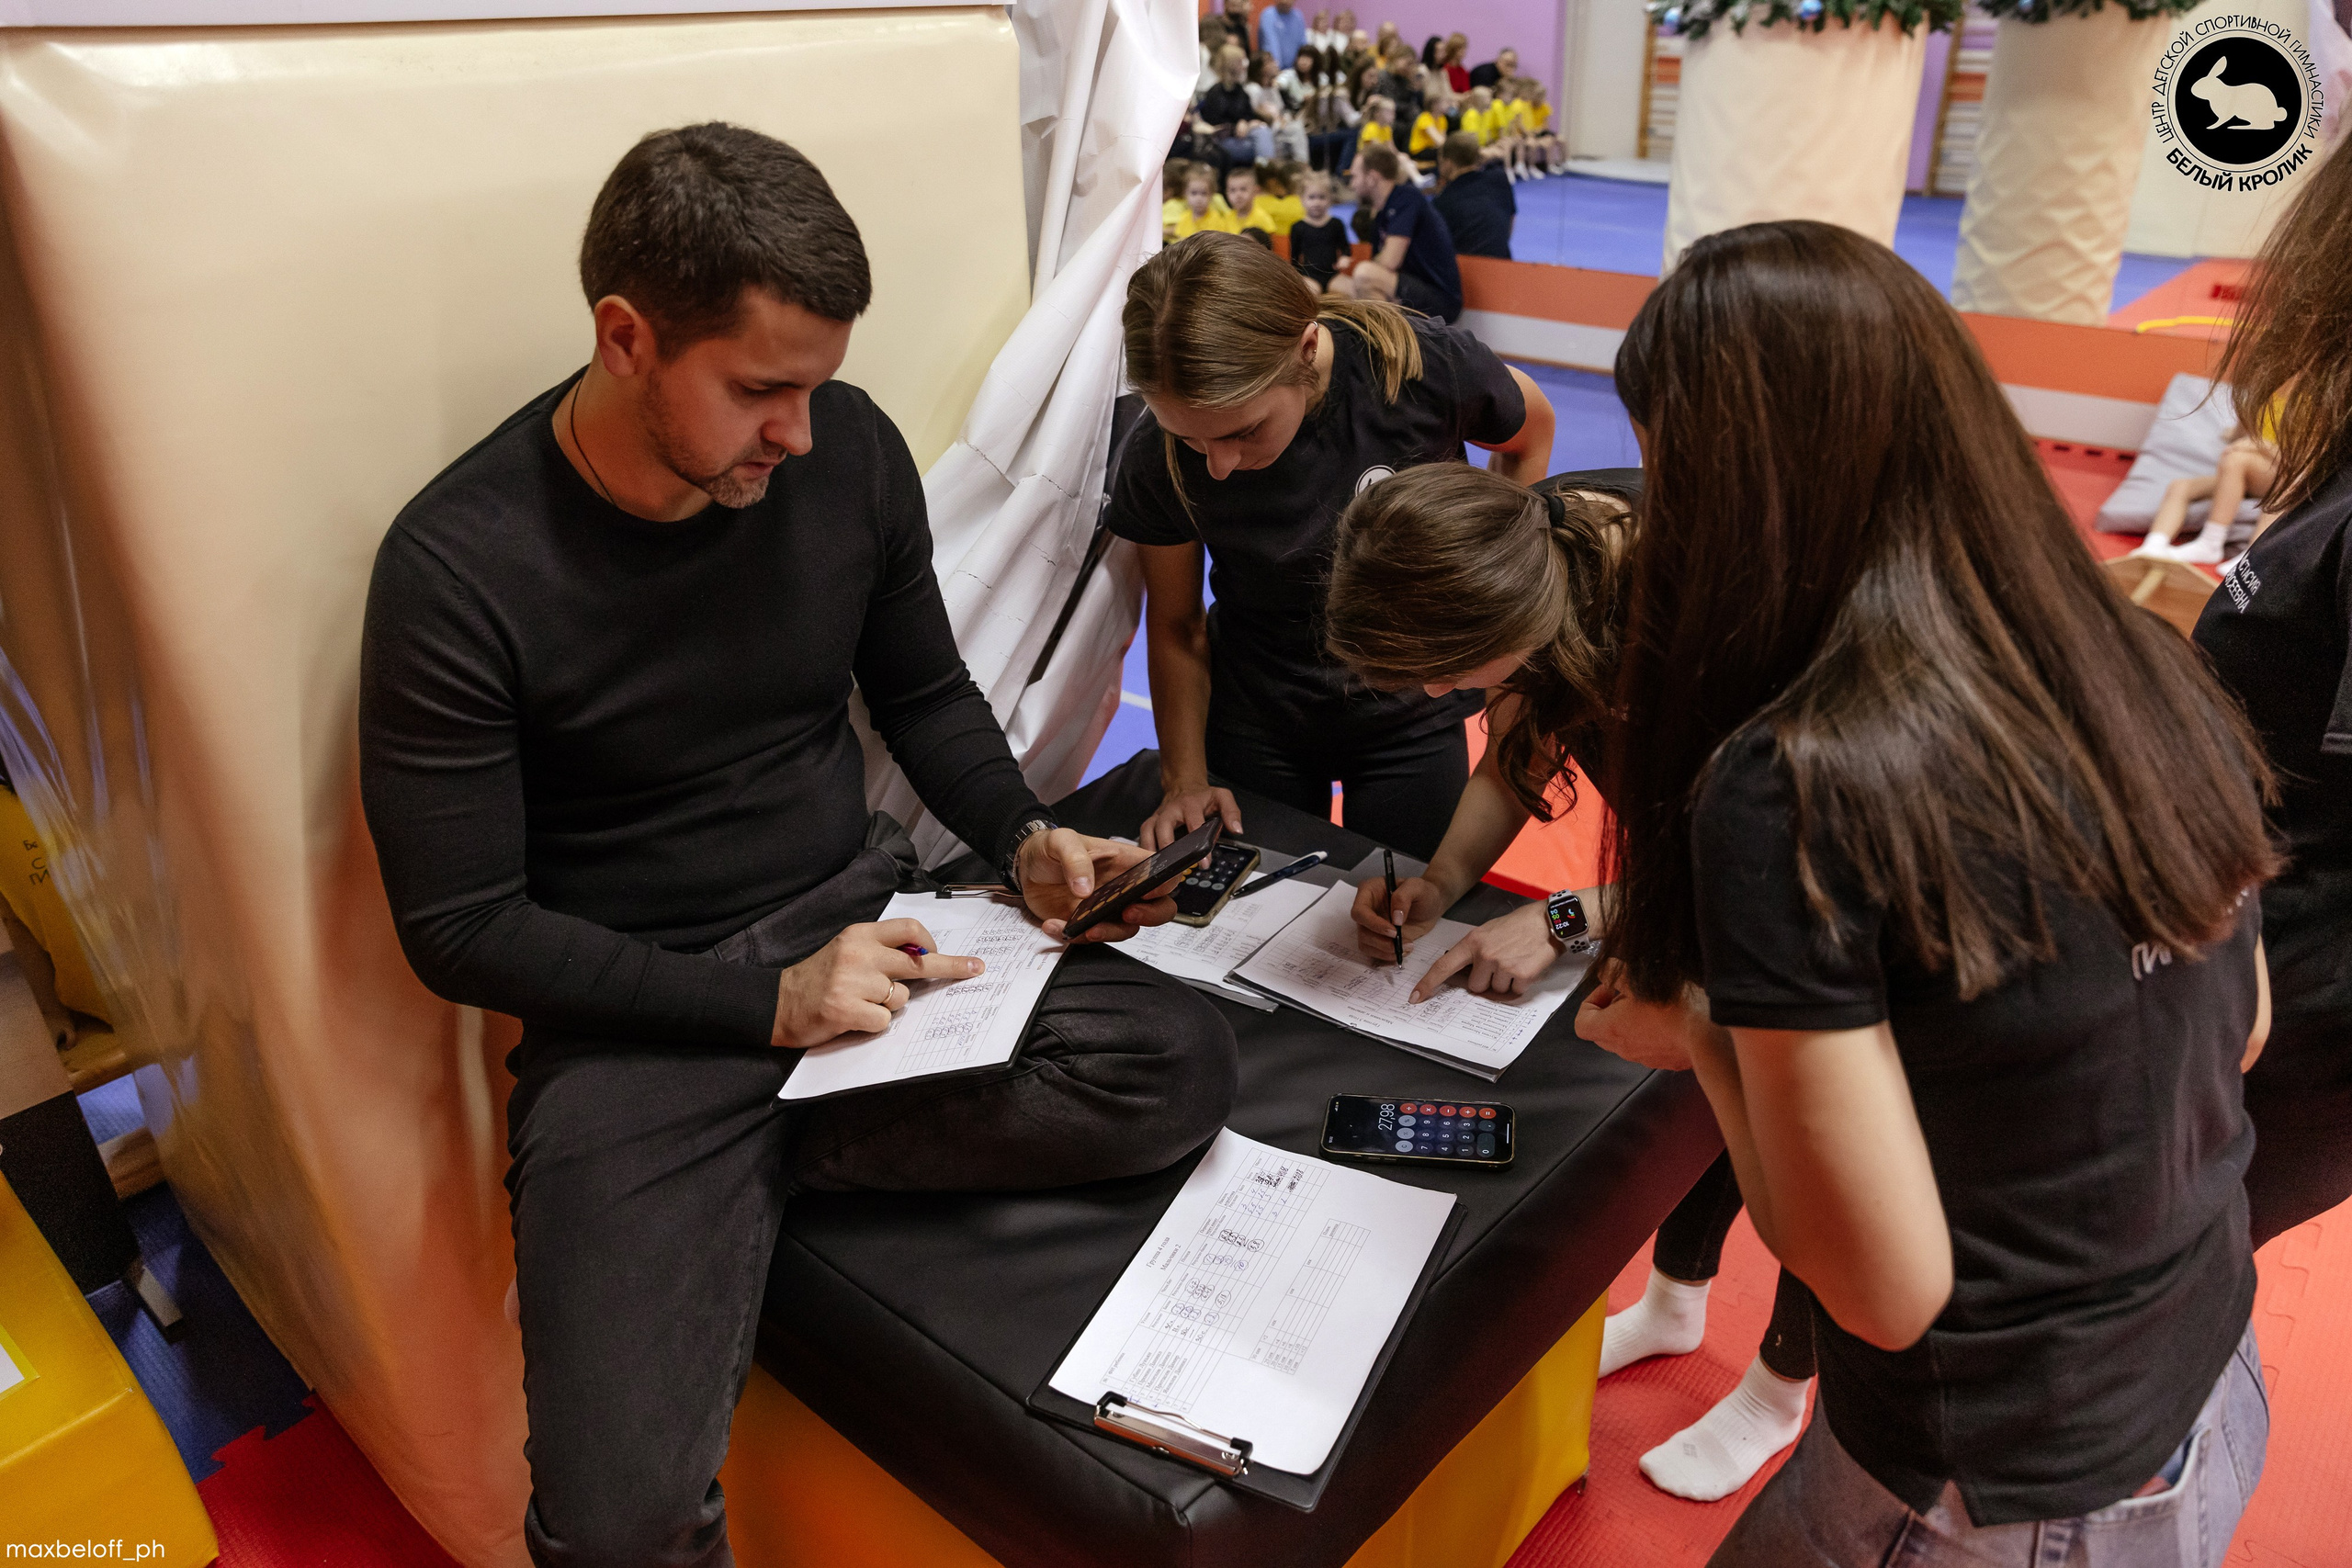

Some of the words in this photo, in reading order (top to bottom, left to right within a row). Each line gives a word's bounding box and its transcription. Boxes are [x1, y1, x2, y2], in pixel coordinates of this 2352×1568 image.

[1555, 921, 1569, 930] 10:22
[1378, 1103, 1395, 1131] 27,98
[1145, 1250, 1162, 1268] Группа
[1159, 1236, 1170, 1247] года
[1159, 1247, 1179, 1270] Мальчики
